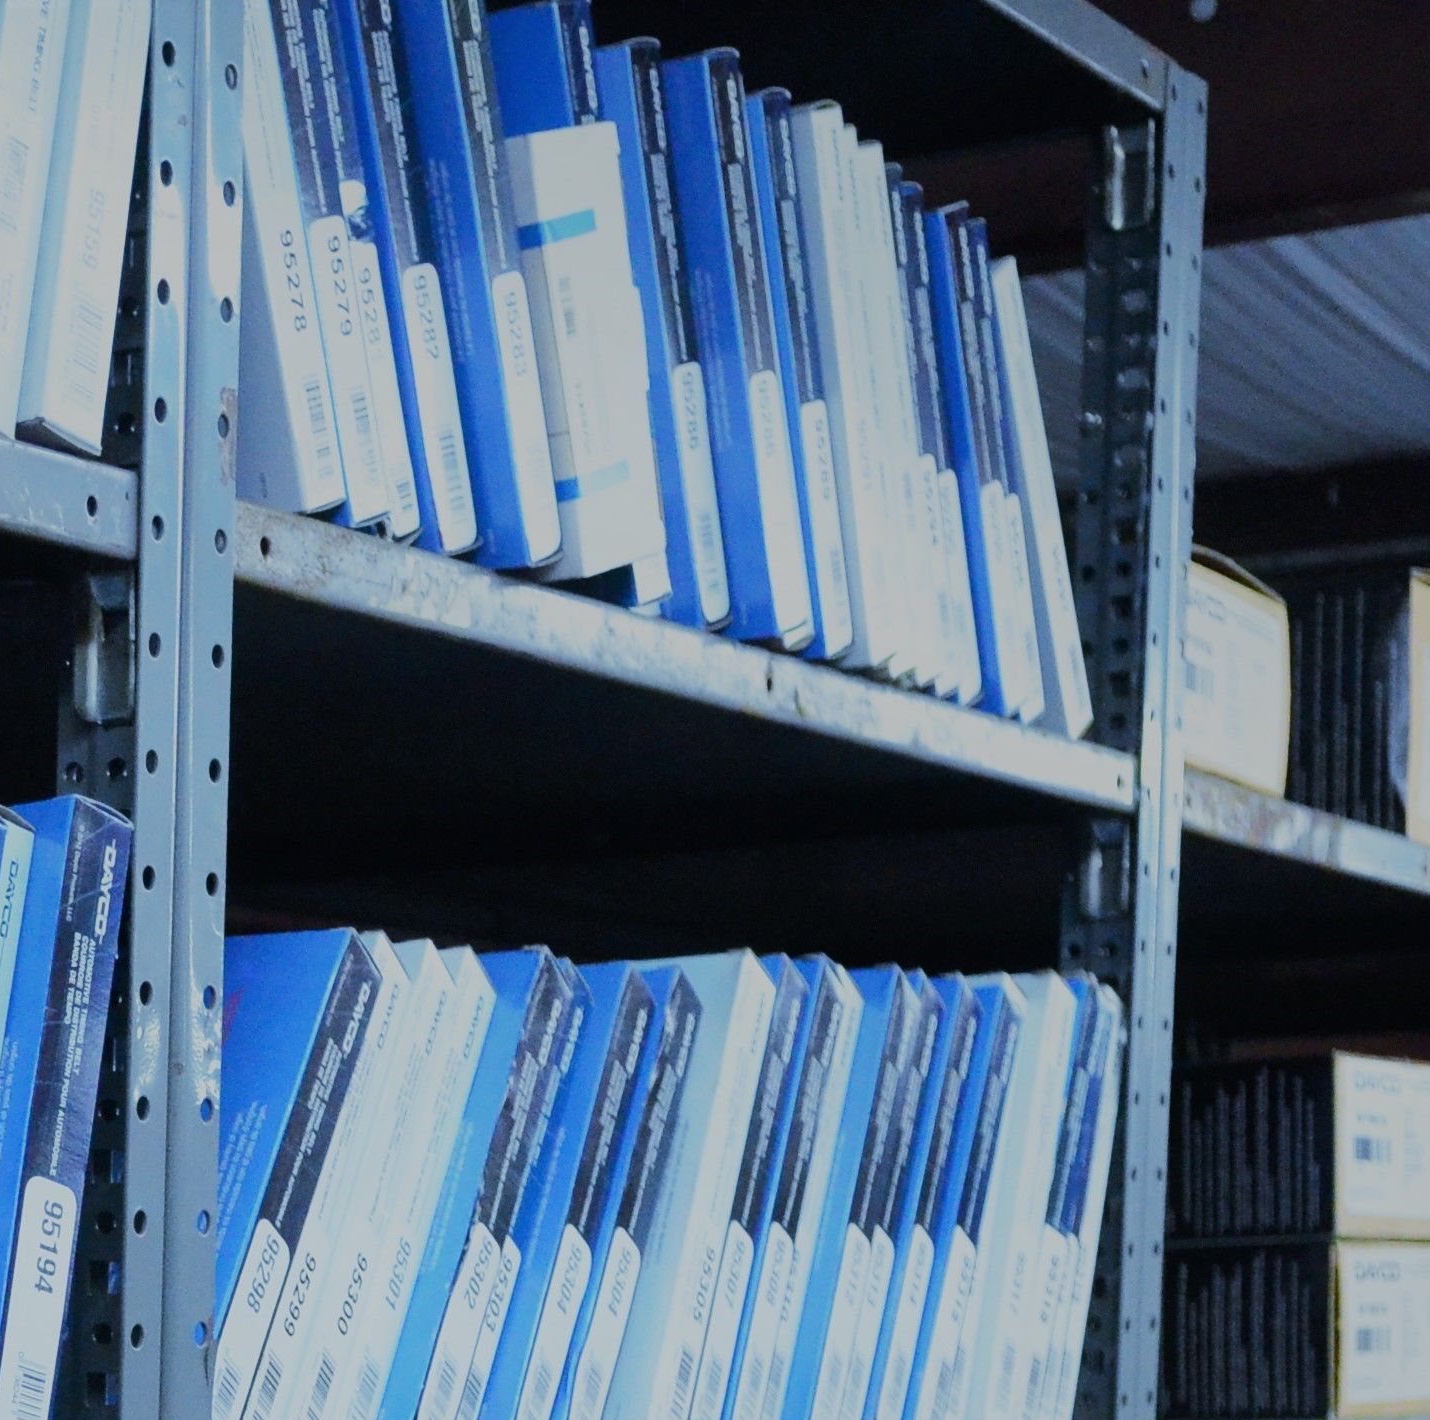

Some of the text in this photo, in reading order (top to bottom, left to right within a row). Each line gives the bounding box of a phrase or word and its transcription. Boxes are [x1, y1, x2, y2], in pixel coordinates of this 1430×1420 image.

[80, 187, 107, 271] 95159
[278, 228, 309, 334] 95278
[326, 234, 355, 337] 95279
[94, 844, 118, 937] DAYCO
[33, 1199, 65, 1294] 95194
[245, 1237, 282, 1314] 95298
[382, 1237, 413, 1313] 95301
[462, 1237, 495, 1312] 95302
[555, 1246, 585, 1316] 95304
[606, 1248, 634, 1318] 95304
[690, 1247, 718, 1323] 95305
[281, 1252, 318, 1338] 95299
[334, 1252, 370, 1338] 95300
[483, 1257, 515, 1334] 95303
